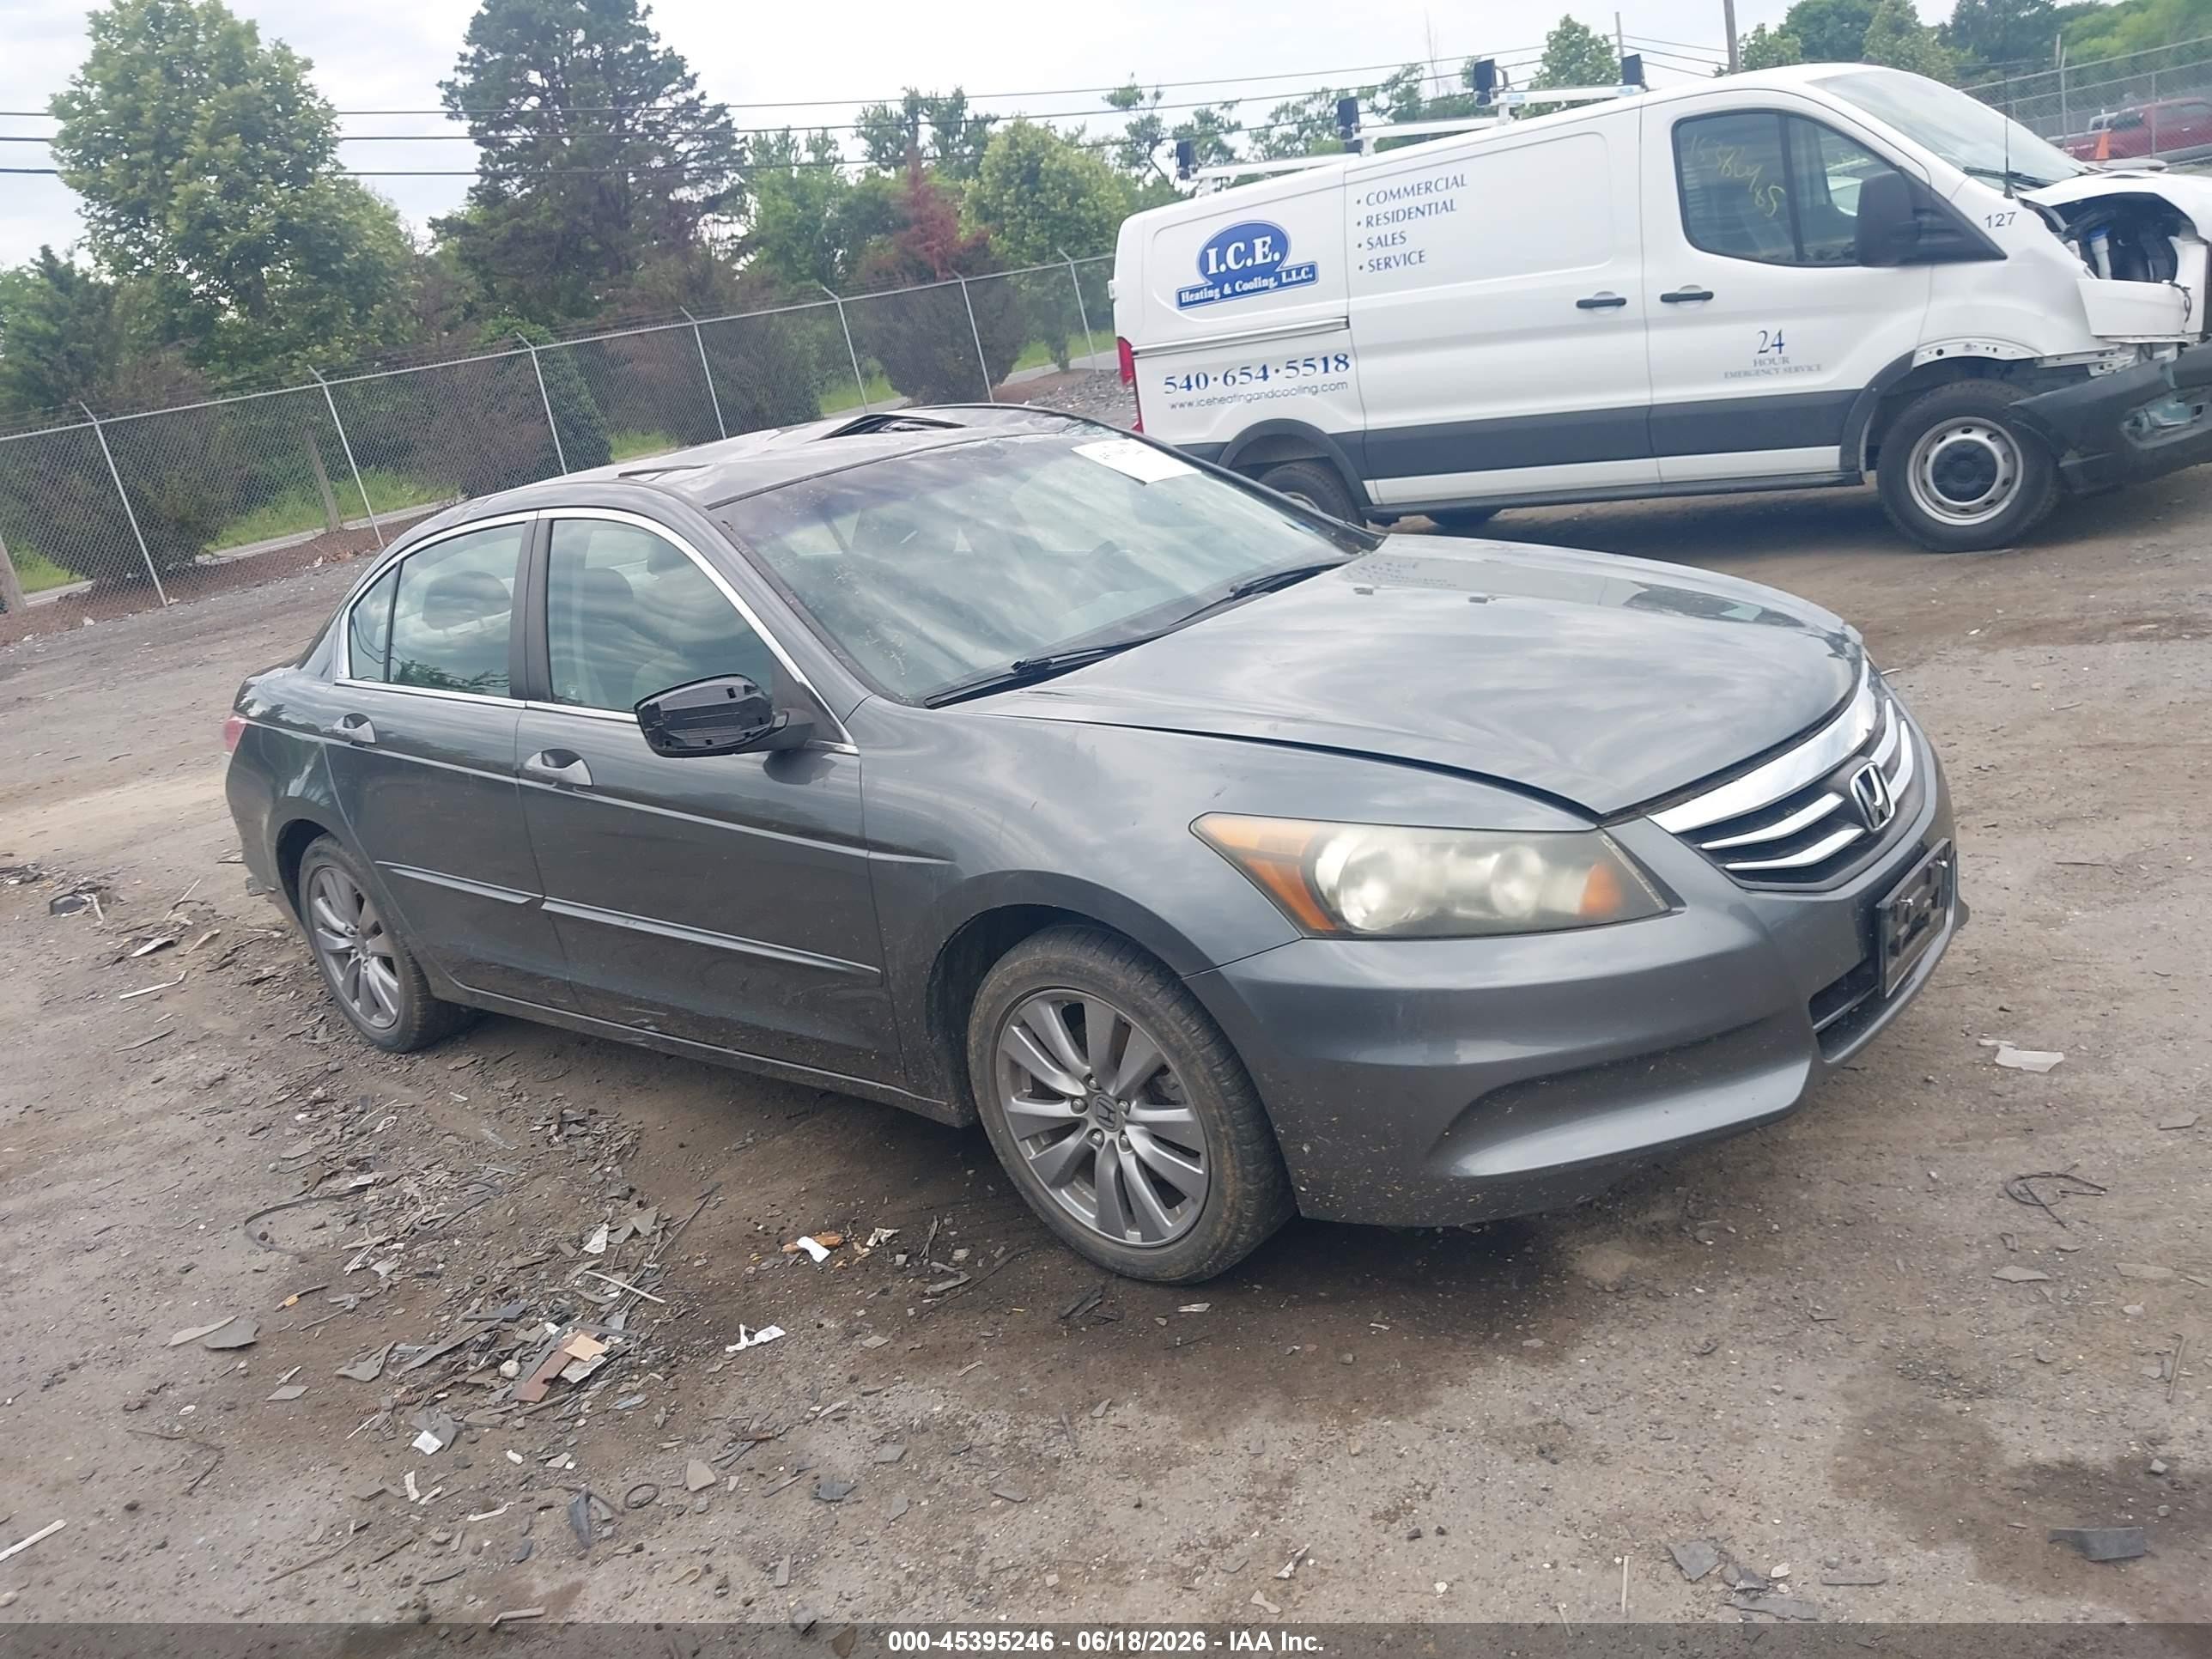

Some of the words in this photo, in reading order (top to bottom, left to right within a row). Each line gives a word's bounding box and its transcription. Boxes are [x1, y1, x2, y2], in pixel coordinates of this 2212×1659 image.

[1365, 173, 1468, 207] COMMERCIAL
[1365, 198, 1457, 228] RESIDENTIAL
[1984, 211, 2017, 228] 127
[1366, 230, 1407, 251] SALES
[1206, 235, 1281, 275] I.C.E.
[1368, 249, 1426, 273] SERVICE
[1180, 287, 1221, 303] Heating
[1223, 283, 1231, 295] &
[1235, 276, 1279, 292] Cooling,
[1280, 267, 1314, 283] L.L.C.
[1757, 329, 1785, 354] 24
[1753, 356, 1790, 368] HOUR
[1169, 380, 1348, 410] www.iceheatingandcooling.com
